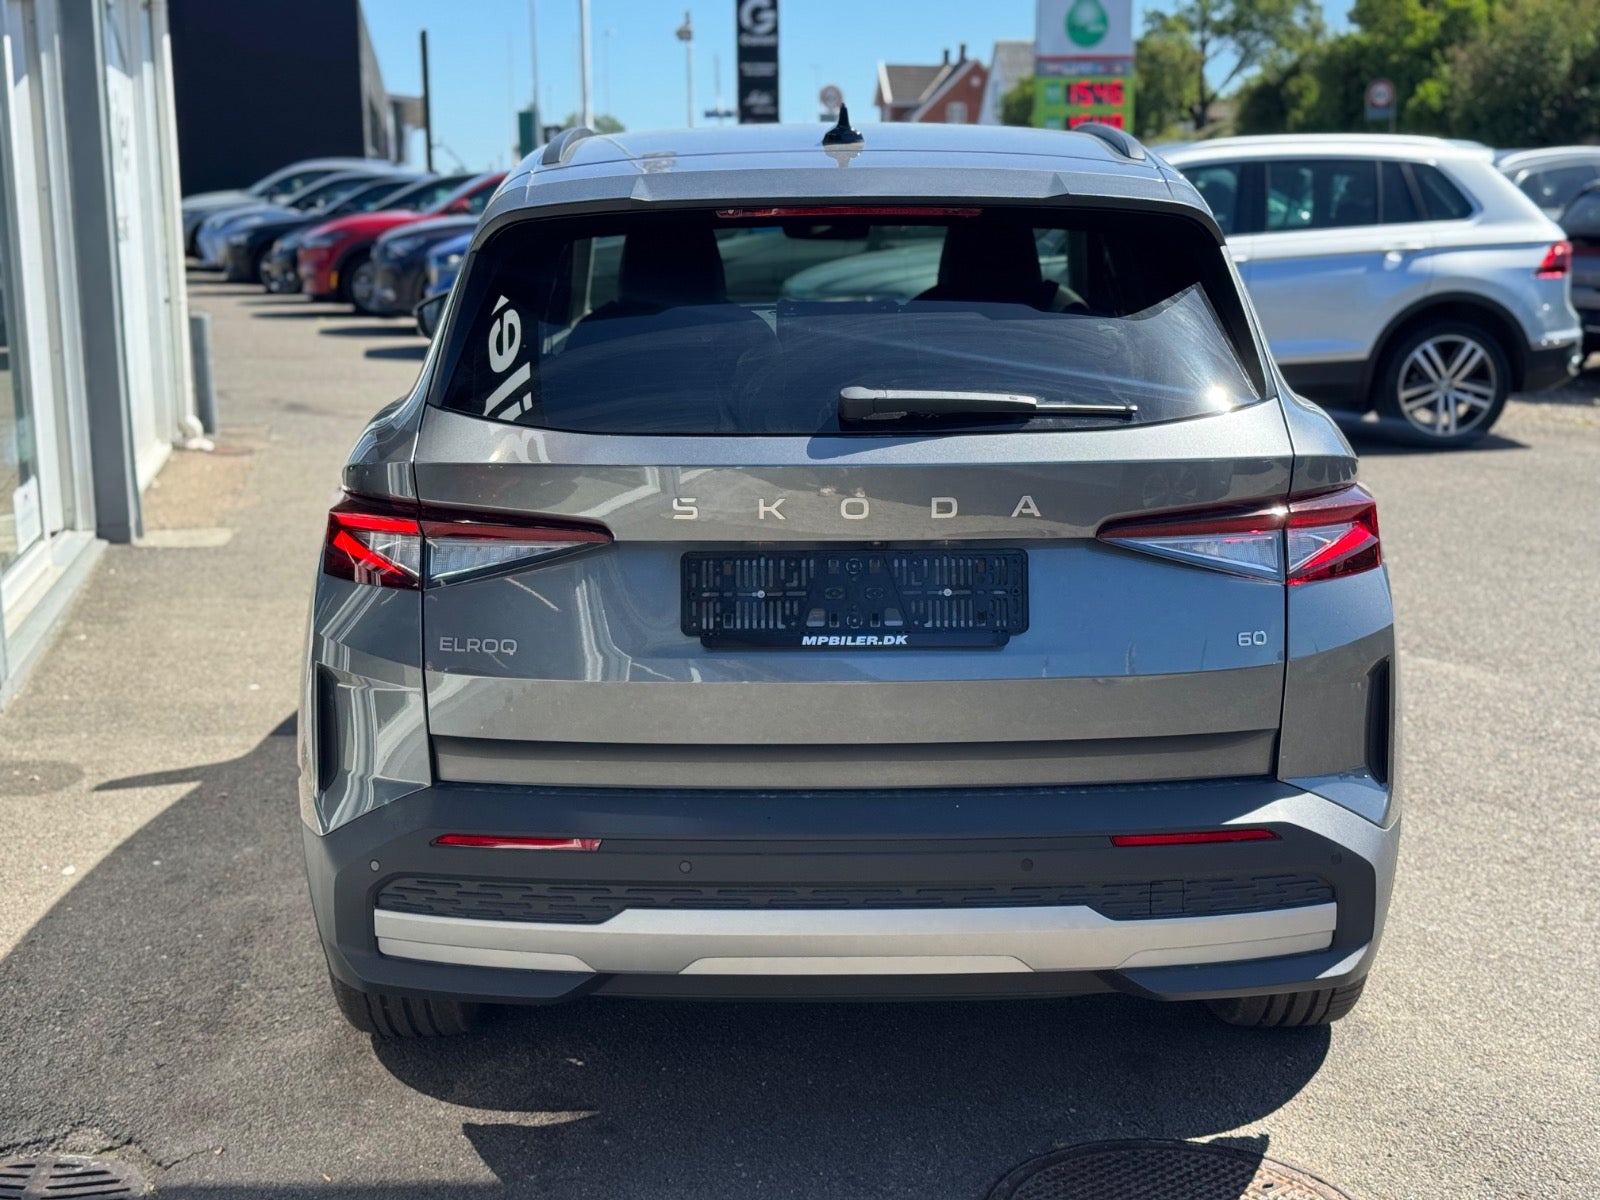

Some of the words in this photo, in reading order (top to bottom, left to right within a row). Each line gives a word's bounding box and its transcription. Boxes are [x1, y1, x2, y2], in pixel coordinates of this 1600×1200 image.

[672, 495, 1042, 520] SKODA
[439, 636, 518, 656] ELROQ
[801, 634, 909, 646] MPBILER.DK
[1237, 630, 1268, 647] 60
